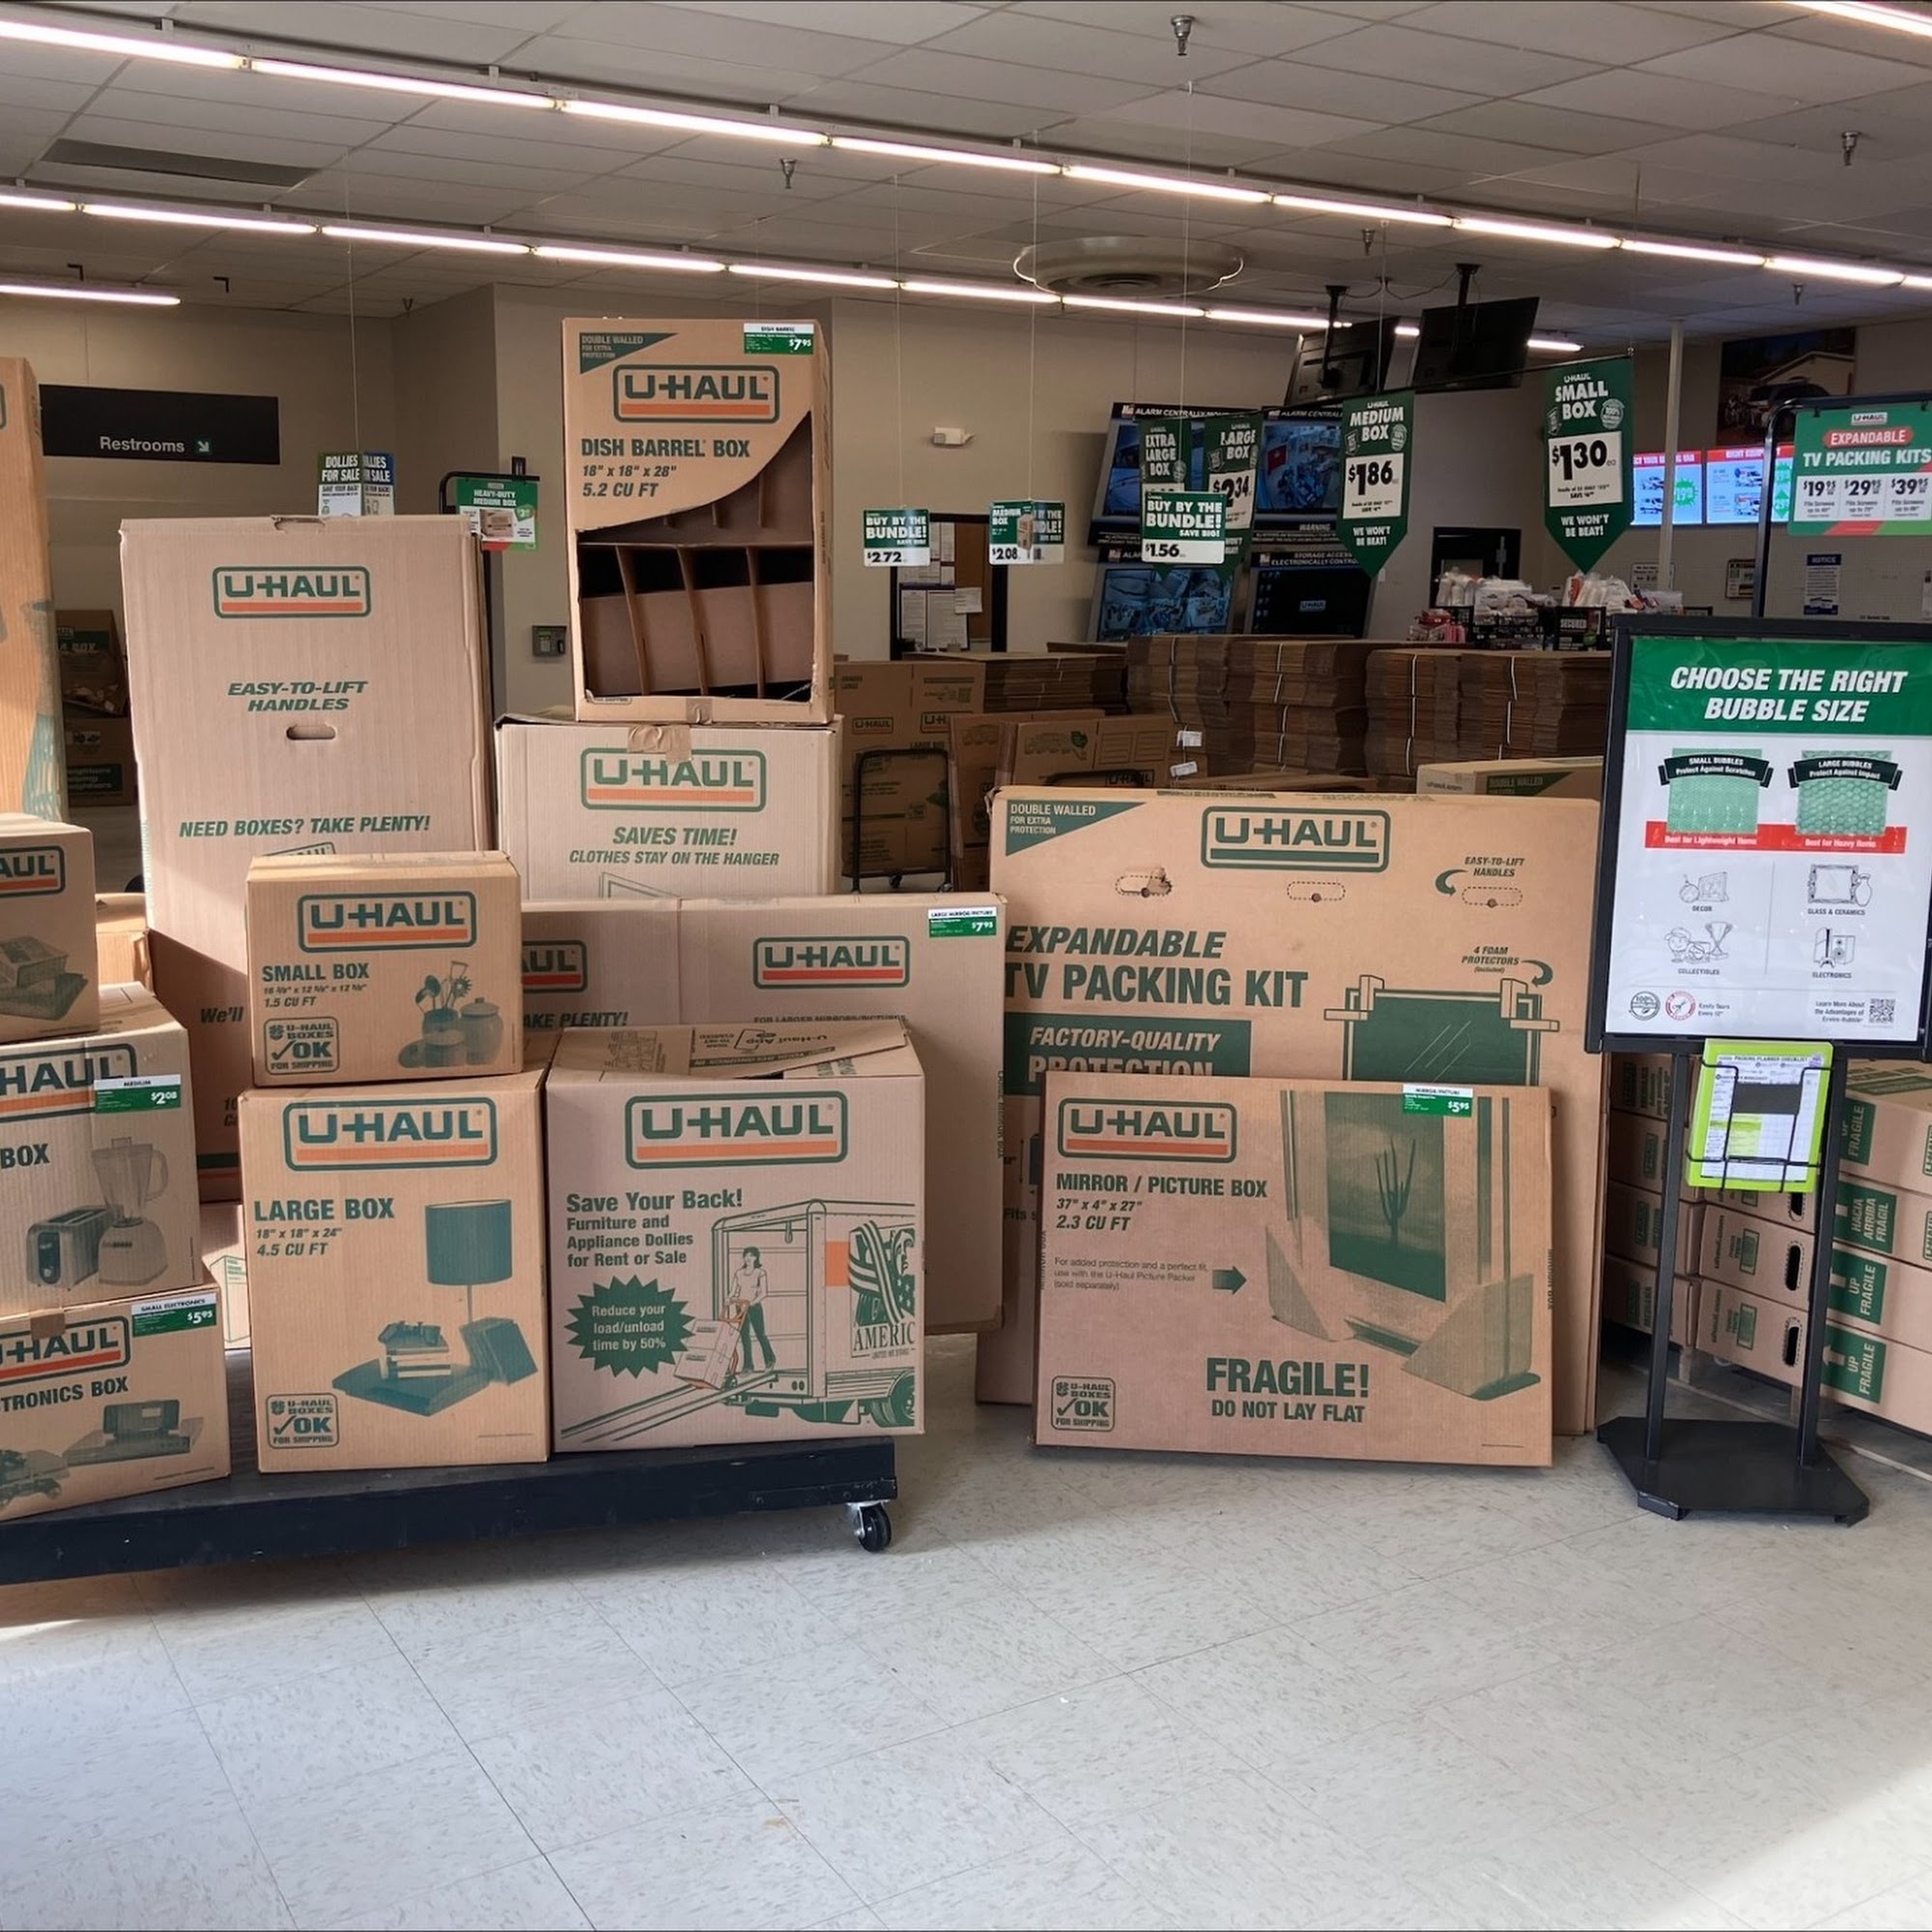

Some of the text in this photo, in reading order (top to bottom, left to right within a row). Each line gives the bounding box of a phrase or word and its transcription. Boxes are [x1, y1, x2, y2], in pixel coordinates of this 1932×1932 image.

[582, 335, 643, 345] DOUBLE WALLED
[624, 374, 769, 400] U-HAUL
[1555, 381, 1608, 402] SMALL
[1350, 407, 1404, 426] MEDIUM
[1562, 400, 1597, 420] BOX
[1146, 433, 1176, 447] EXTRA
[1220, 430, 1256, 445] LARGE
[1361, 424, 1389, 441] BOX
[1831, 430, 1907, 445] EXPANDABLE
[99, 436, 185, 453] Restrooms
[582, 439, 751, 457] DISH BARREL BOX
[1146, 447, 1176, 461] LARGE
[1226, 445, 1249, 460] BOX
[1803, 448, 1932, 467] TV PACKING KITS
[326, 455, 358, 469] DOLLIES
[1150, 463, 1171, 475] BOX
[322, 469, 360, 482] FOR SALE
[372, 469, 390, 482] SALE
[473, 489, 516, 498] HEAVY-DUTY
[582, 483, 659, 497] 5.2 CU FT
[473, 497, 516, 507] MEDIUM BOX
[1148, 500, 1222, 513] BUY BY THE
[992, 507, 1021, 517] MEDIUM
[866, 515, 926, 526] BUY BY THE
[992, 517, 1009, 526] BOX
[1146, 513, 1221, 528] BUNDLE!
[1561, 514, 1609, 526] WE WON'T
[866, 526, 926, 539] BUNDLE!
[1353, 526, 1391, 536] WE WON'T
[1565, 526, 1604, 537] BE BEAT!
[1356, 536, 1386, 546] BE BEAT!
[224, 575, 361, 598] U-HAUL
[1670, 667, 1909, 694] CHOOSE THE RIGHT
[228, 681, 368, 696] EASY-TO-LIFT
[247, 698, 349, 712] HANDLES
[1704, 697, 1870, 723] BUBBLE SIZE
[1690, 756, 1744, 766] SMALL BUBBLES
[1818, 759, 1872, 770] LARGE BUBBLES
[593, 759, 754, 787] U-HAUL
[1676, 765, 1756, 778] Protect Against Scratches
[1809, 768, 1881, 781] Protect Against Impact
[1010, 804, 1095, 816] DOUBLE WALLED
[179, 816, 431, 837] NEED BOXES? TAKE PLENTY!
[1010, 816, 1051, 825] FOR EXTRA
[613, 827, 737, 846] SAVES TIME!
[1010, 826, 1057, 835] PROTECTION
[1215, 817, 1378, 848] U-HAUL
[1694, 836, 1736, 846] Lightweight
[1833, 838, 1855, 849] Heavy
[569, 850, 780, 866] CLOTHES STAY ON THE HANGER
[1464, 857, 1525, 867] EASY-TO-LIFT
[1473, 867, 1516, 877] HANDLES
[310, 900, 466, 929] U-HAUL
[1006, 925, 1227, 958] EXPANDABLE
[765, 945, 900, 969] U-HAUL
[1481, 947, 1509, 955] FOAM
[1462, 955, 1520, 966] PROTECTORS
[263, 963, 369, 982] SMALL BOX
[1005, 964, 1308, 1008] TV PACKING KIT
[1030, 1027, 1222, 1052] FACTORY-QUALITY
[298, 1110, 483, 1143] U-HAUL
[641, 1105, 834, 1139] U-HAUL
[1070, 1109, 1226, 1139] U-HAUL
[1848, 1104, 1865, 1157] FRAGILE
[1057, 1174, 1267, 1198] MIRROR PICTURE BOX
[567, 1188, 743, 1211] Save Your Back!
[254, 1198, 394, 1222] LARGE BOX
[1851, 1198, 1864, 1232] HACIA
[567, 1215, 669, 1231] Furniture and
[1057, 1216, 1130, 1231] 2.3 CU FT
[1863, 1198, 1877, 1240] ARRIBA
[1876, 1203, 1889, 1252] FRAGIL
[567, 1233, 694, 1252] Appliance Dollies
[568, 1251, 687, 1267] for Rent or Sale
[1055, 1258, 1196, 1271] For added protection and perfect
[1072, 1269, 1195, 1282] with the U-Haul Picture Packer
[1849, 1277, 1858, 1294] UP
[1860, 1264, 1875, 1316] FRAGILE
[592, 1304, 666, 1318] Reduce your
[593, 1321, 665, 1334] load/unload
[592, 1338, 666, 1353] time by 50%
[1848, 1355, 1858, 1373] UP
[1860, 1343, 1875, 1395] FRAGILE
[1207, 1357, 1370, 1398] FRAGILE!
[91, 1377, 129, 1397] BOX
[1211, 1400, 1366, 1423] DO NOT LAY FLAT
